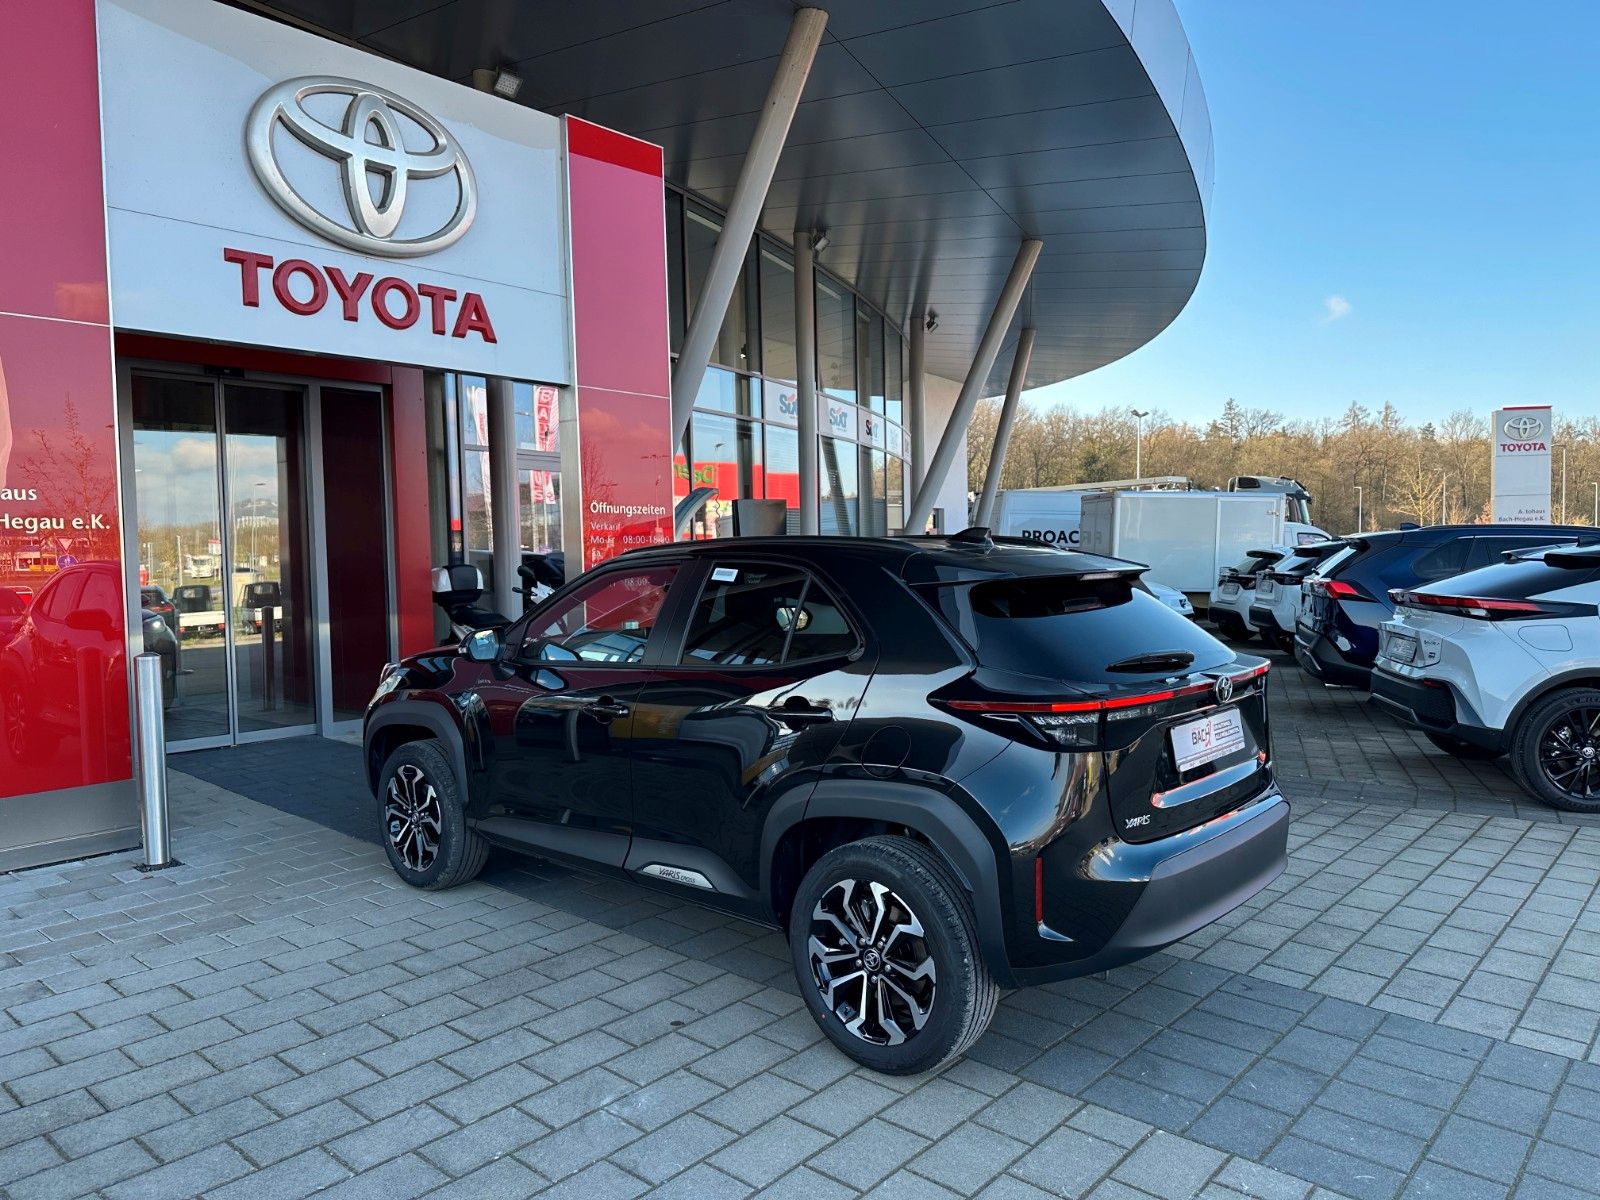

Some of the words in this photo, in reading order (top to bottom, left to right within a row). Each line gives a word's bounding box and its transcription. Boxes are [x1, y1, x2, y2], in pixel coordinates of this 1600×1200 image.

[223, 247, 498, 344] TOYOTA
[1500, 443, 1546, 452] TOYOTA
[590, 501, 666, 517] Öffnungszeiten
[71, 513, 111, 530] e.K.
[1125, 814, 1150, 829] YARIS
